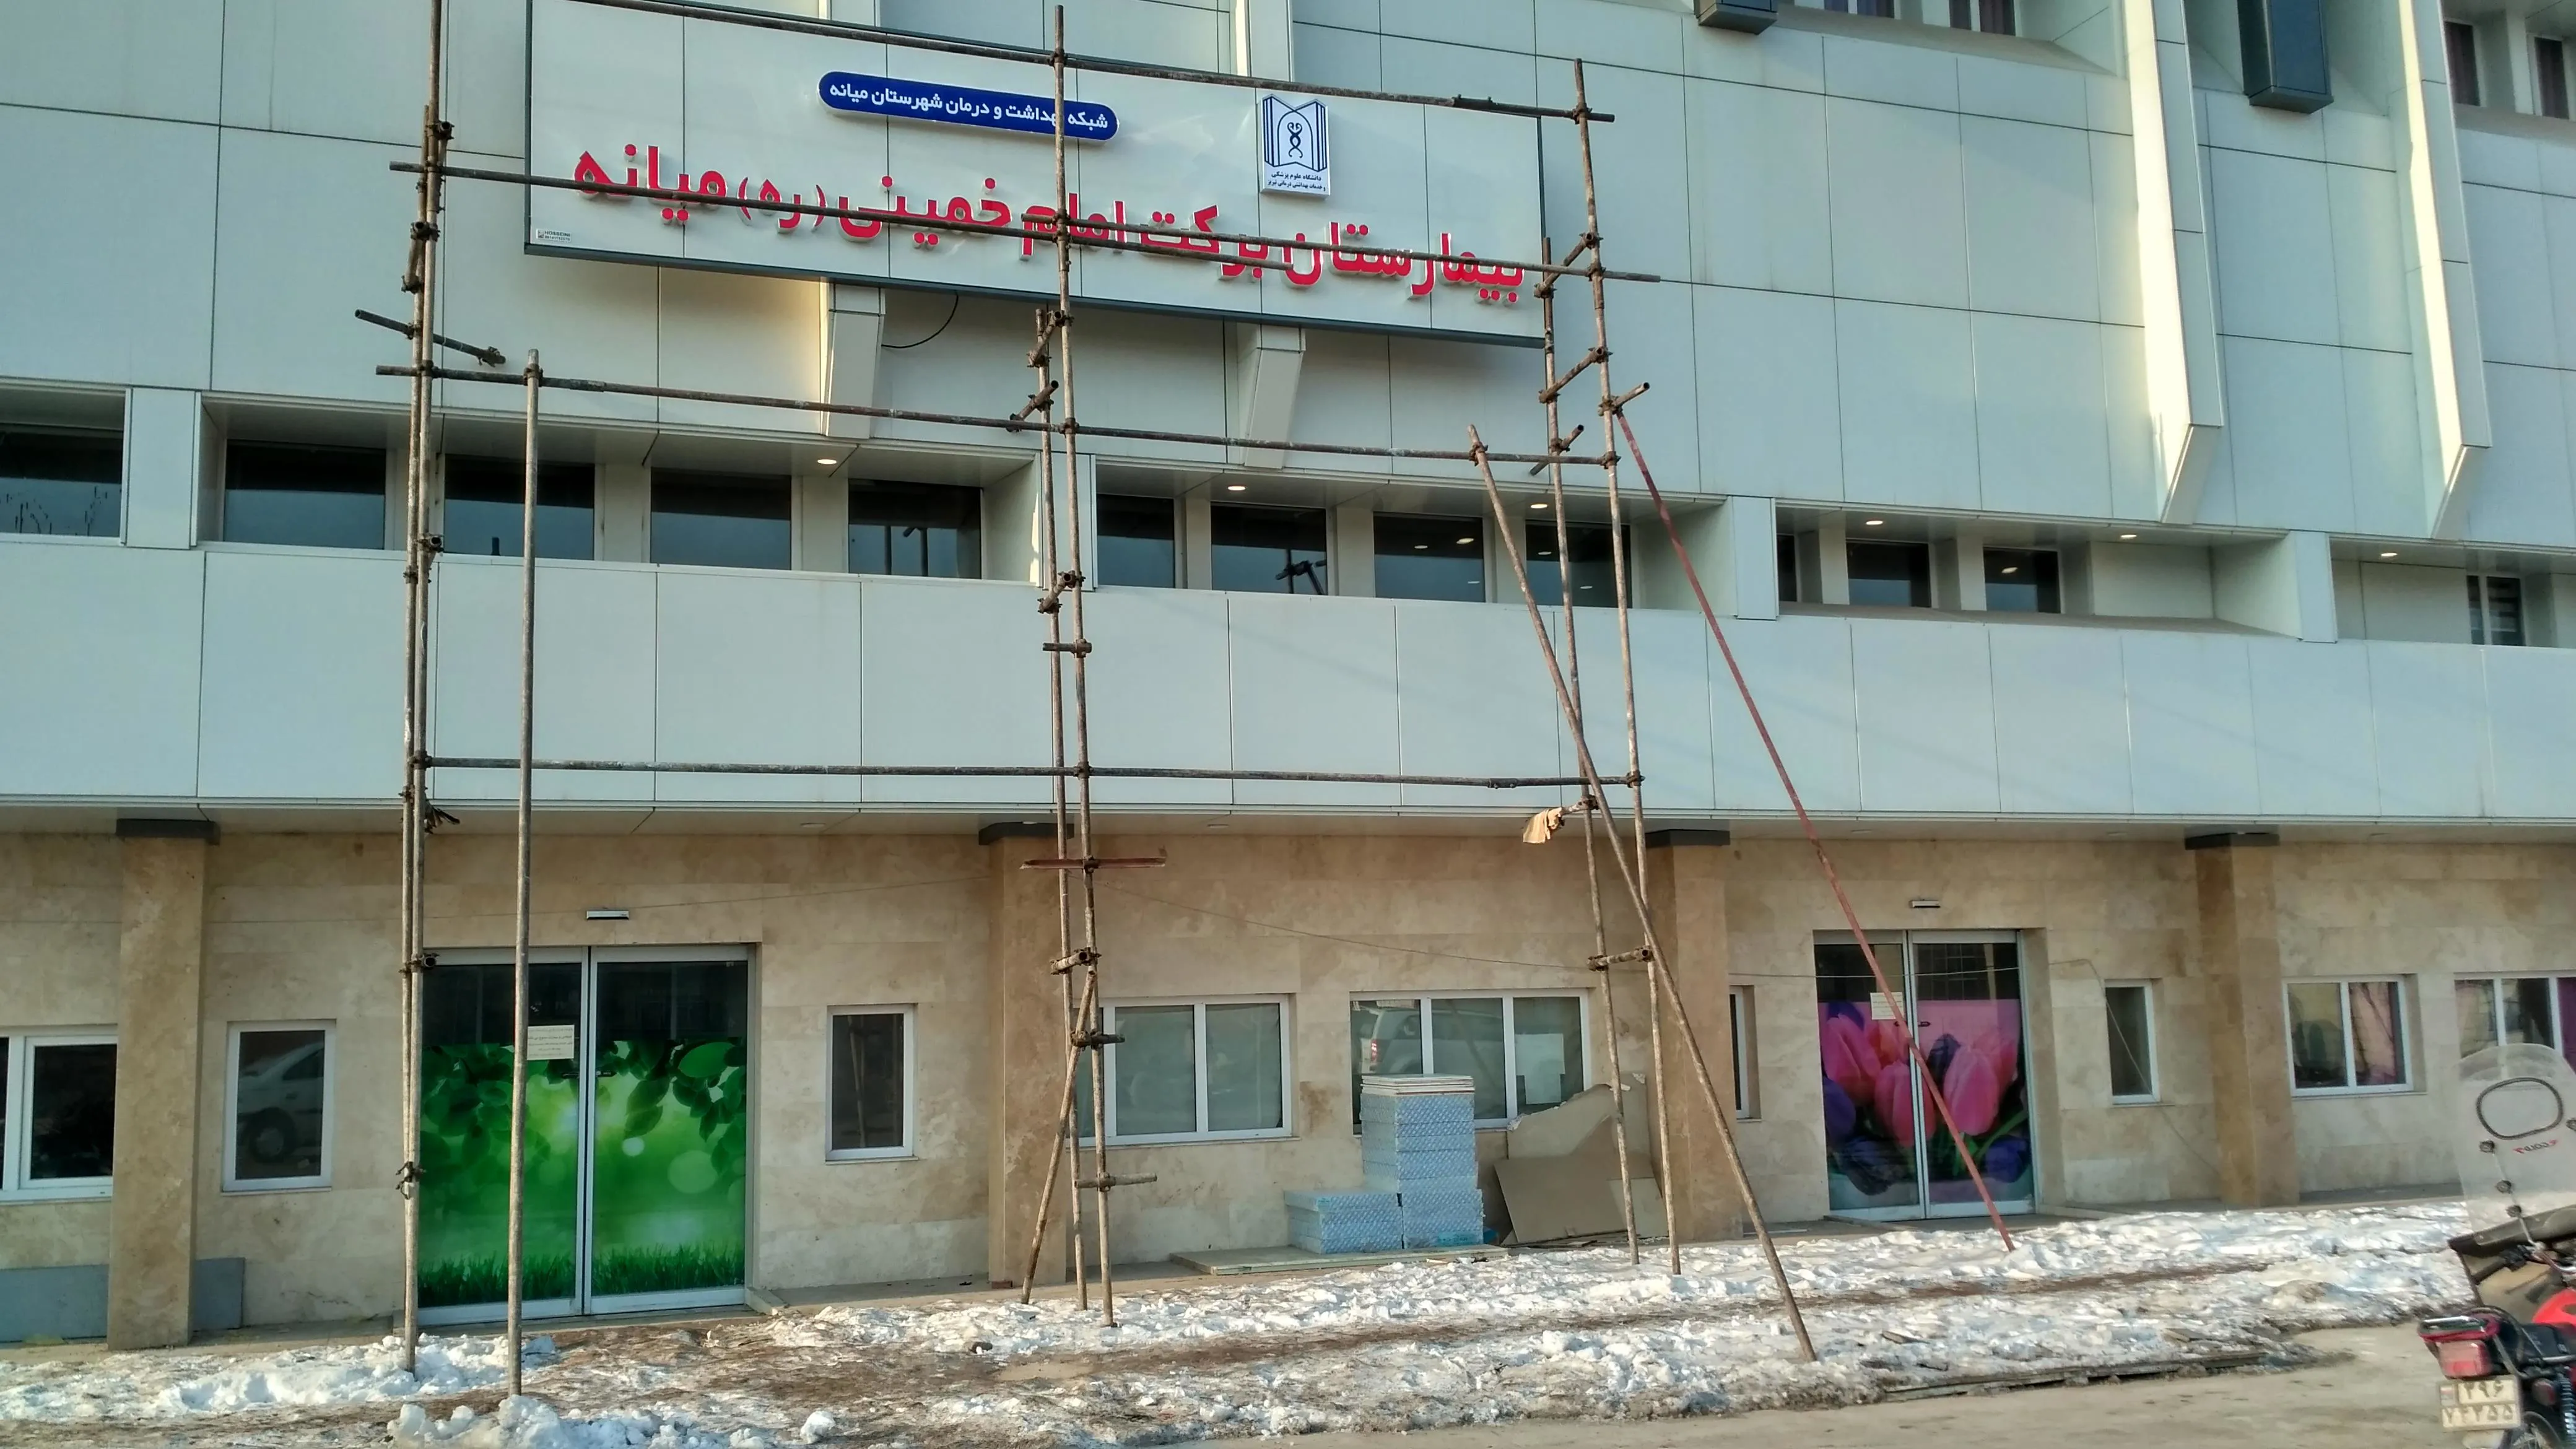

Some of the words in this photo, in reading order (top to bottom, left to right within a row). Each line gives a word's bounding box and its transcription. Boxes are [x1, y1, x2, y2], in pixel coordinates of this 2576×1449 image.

[830, 83, 868, 103] میانه
[871, 88, 942, 111] شهرستان
[946, 97, 990, 118] درمان
[993, 105, 1002, 120] و
[1006, 105, 1056, 128] هداشت
[1068, 111, 1108, 131] شبکه
[574, 144, 727, 222] میانه
[838, 175, 1012, 245] خمینی
[1022, 193, 1126, 256] امام
[1140, 206, 1268, 279] برکت
[1282, 222, 1523, 302] بیمارستان
